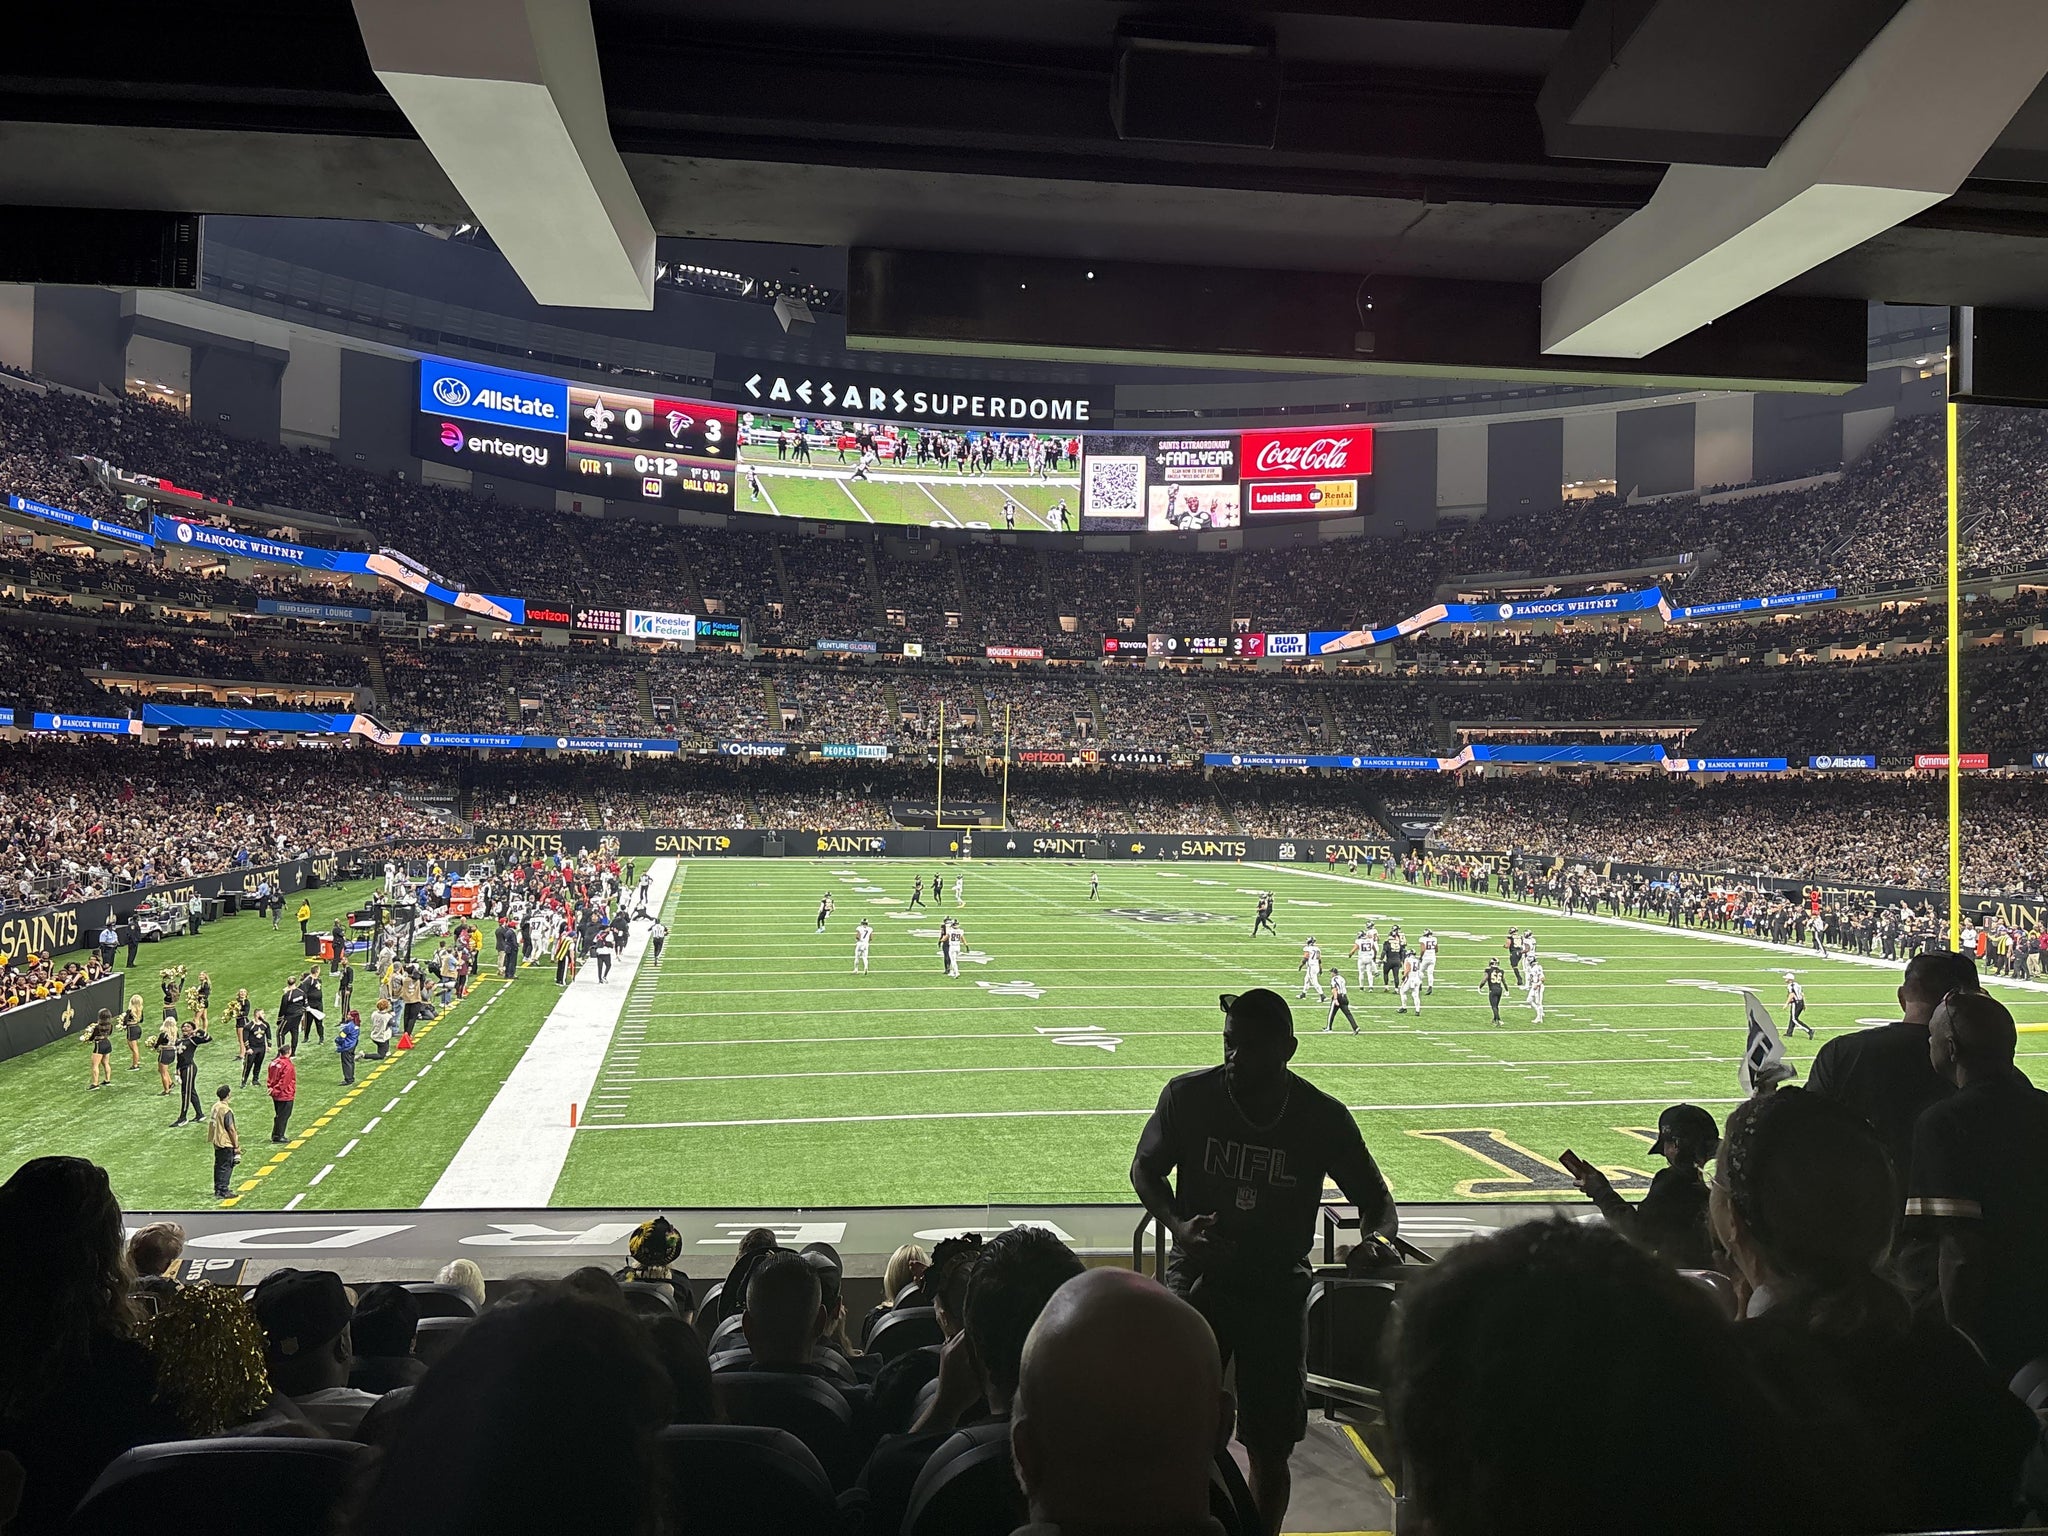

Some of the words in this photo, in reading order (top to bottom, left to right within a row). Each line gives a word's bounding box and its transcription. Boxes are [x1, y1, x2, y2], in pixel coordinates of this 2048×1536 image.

[472, 388, 555, 419] Allstate
[744, 373, 915, 414] CAESARS
[913, 391, 1091, 422] SUPERDOME
[624, 408, 643, 432] 0
[704, 419, 722, 443] 3
[468, 435, 549, 468] entergy
[1158, 441, 1180, 450] SAINTS
[1166, 451, 1190, 466] FAN
[1199, 451, 1234, 466] YEAR
[1256, 437, 1354, 473] Coca-Cola
[579, 458, 601, 476] QTR
[604, 462, 613, 477] 1
[633, 455, 679, 476] 0:12
[708, 469, 721, 482] 10
[644, 481, 659, 495] 40
[682, 478, 703, 493] BALL
[703, 480, 716, 493] ON
[716, 481, 729, 495] 23
[1256, 491, 1303, 504] Louisiana
[1324, 490, 1353, 500] Rental
[25, 503, 49, 518] HANCOCK
[50, 508, 75, 523] WHITNEY
[99, 523, 121, 536] HANCOCK
[121, 528, 145, 542] WHITNEY
[195, 531, 248, 551] HANCOCK
[249, 541, 305, 561] WHITNEY
[1990, 562, 2027, 576] SAINTS
[30, 569, 63, 584] SAINTS
[101, 581, 136, 594] SAINTS
[1843, 584, 1876, 597] SAINTS
[178, 590, 214, 604] SAINTS
[1769, 596, 1796, 605] HANCOCK
[1796, 592, 1824, 601] WHITNEY
[293, 606, 322, 616] LIGHT
[324, 608, 354, 619] LOUNGE
[1516, 603, 1565, 615] HANCOCK
[1568, 599, 1619, 611] WHITNEY
[1692, 606, 1715, 614] HANCOCK
[1716, 603, 1742, 612] WHITNEY
[525, 607, 570, 623] verizon
[588, 608, 621, 619] PATRON
[588, 615, 621, 625] SAINTS
[655, 615, 692, 628] Keesler
[712, 620, 740, 631] Keesler
[2005, 615, 2041, 627] SAINTS
[576, 621, 622, 632] PARTNERS
[654, 625, 691, 637] Federal
[712, 628, 740, 638] Federal
[1858, 630, 1890, 641] SAINTS
[780, 637, 810, 647] SAINTS
[817, 641, 849, 651] VENTURE
[849, 643, 876, 652] GLOBAL
[1118, 641, 1147, 650] TOYOTA
[1167, 637, 1177, 650] 0
[1193, 637, 1215, 648] 0:12
[1233, 637, 1243, 650] 3
[1274, 635, 1299, 646] BUD
[1727, 642, 1756, 651] SAINTS
[1790, 637, 1820, 646] SAINTS
[950, 645, 977, 654] SAINTS
[986, 648, 1012, 657] ROUSES
[1012, 648, 1043, 658] MARKETS
[1269, 644, 1304, 654] LIGHT
[1593, 649, 1624, 658] SAINTS
[1659, 646, 1689, 656] SAINTS
[1463, 652, 1493, 661] SAINTS
[1528, 651, 1558, 660] SAINTS
[62, 718, 91, 729] HANCOCK
[91, 720, 121, 730] WHITNEY
[433, 736, 471, 745] HANCOCK
[472, 737, 511, 746] WHITNEY
[569, 739, 601, 749] HANCOCK
[602, 741, 643, 750] WHITNEY
[680, 740, 714, 750] SAINTS
[729, 743, 786, 756] Ochsner
[823, 746, 856, 756] PEOPLES
[858, 746, 887, 757] HEALTH
[898, 746, 928, 755] SAINTS
[964, 747, 994, 756] SAINTS
[1018, 750, 1066, 762] verizon
[1081, 751, 1097, 762] 40
[1110, 753, 1163, 763] CAESARS
[1170, 752, 1201, 761] SAINTS
[1275, 757, 1308, 765] WHITNEY
[1831, 756, 1866, 768] Allstate
[1880, 756, 1913, 766] SAINTS
[906, 807, 986, 817] SAINTS
[1, 908, 78, 957] SAINTS
[1491, 971, 1502, 984] 56
[1204, 1137, 1297, 1188] NFL
